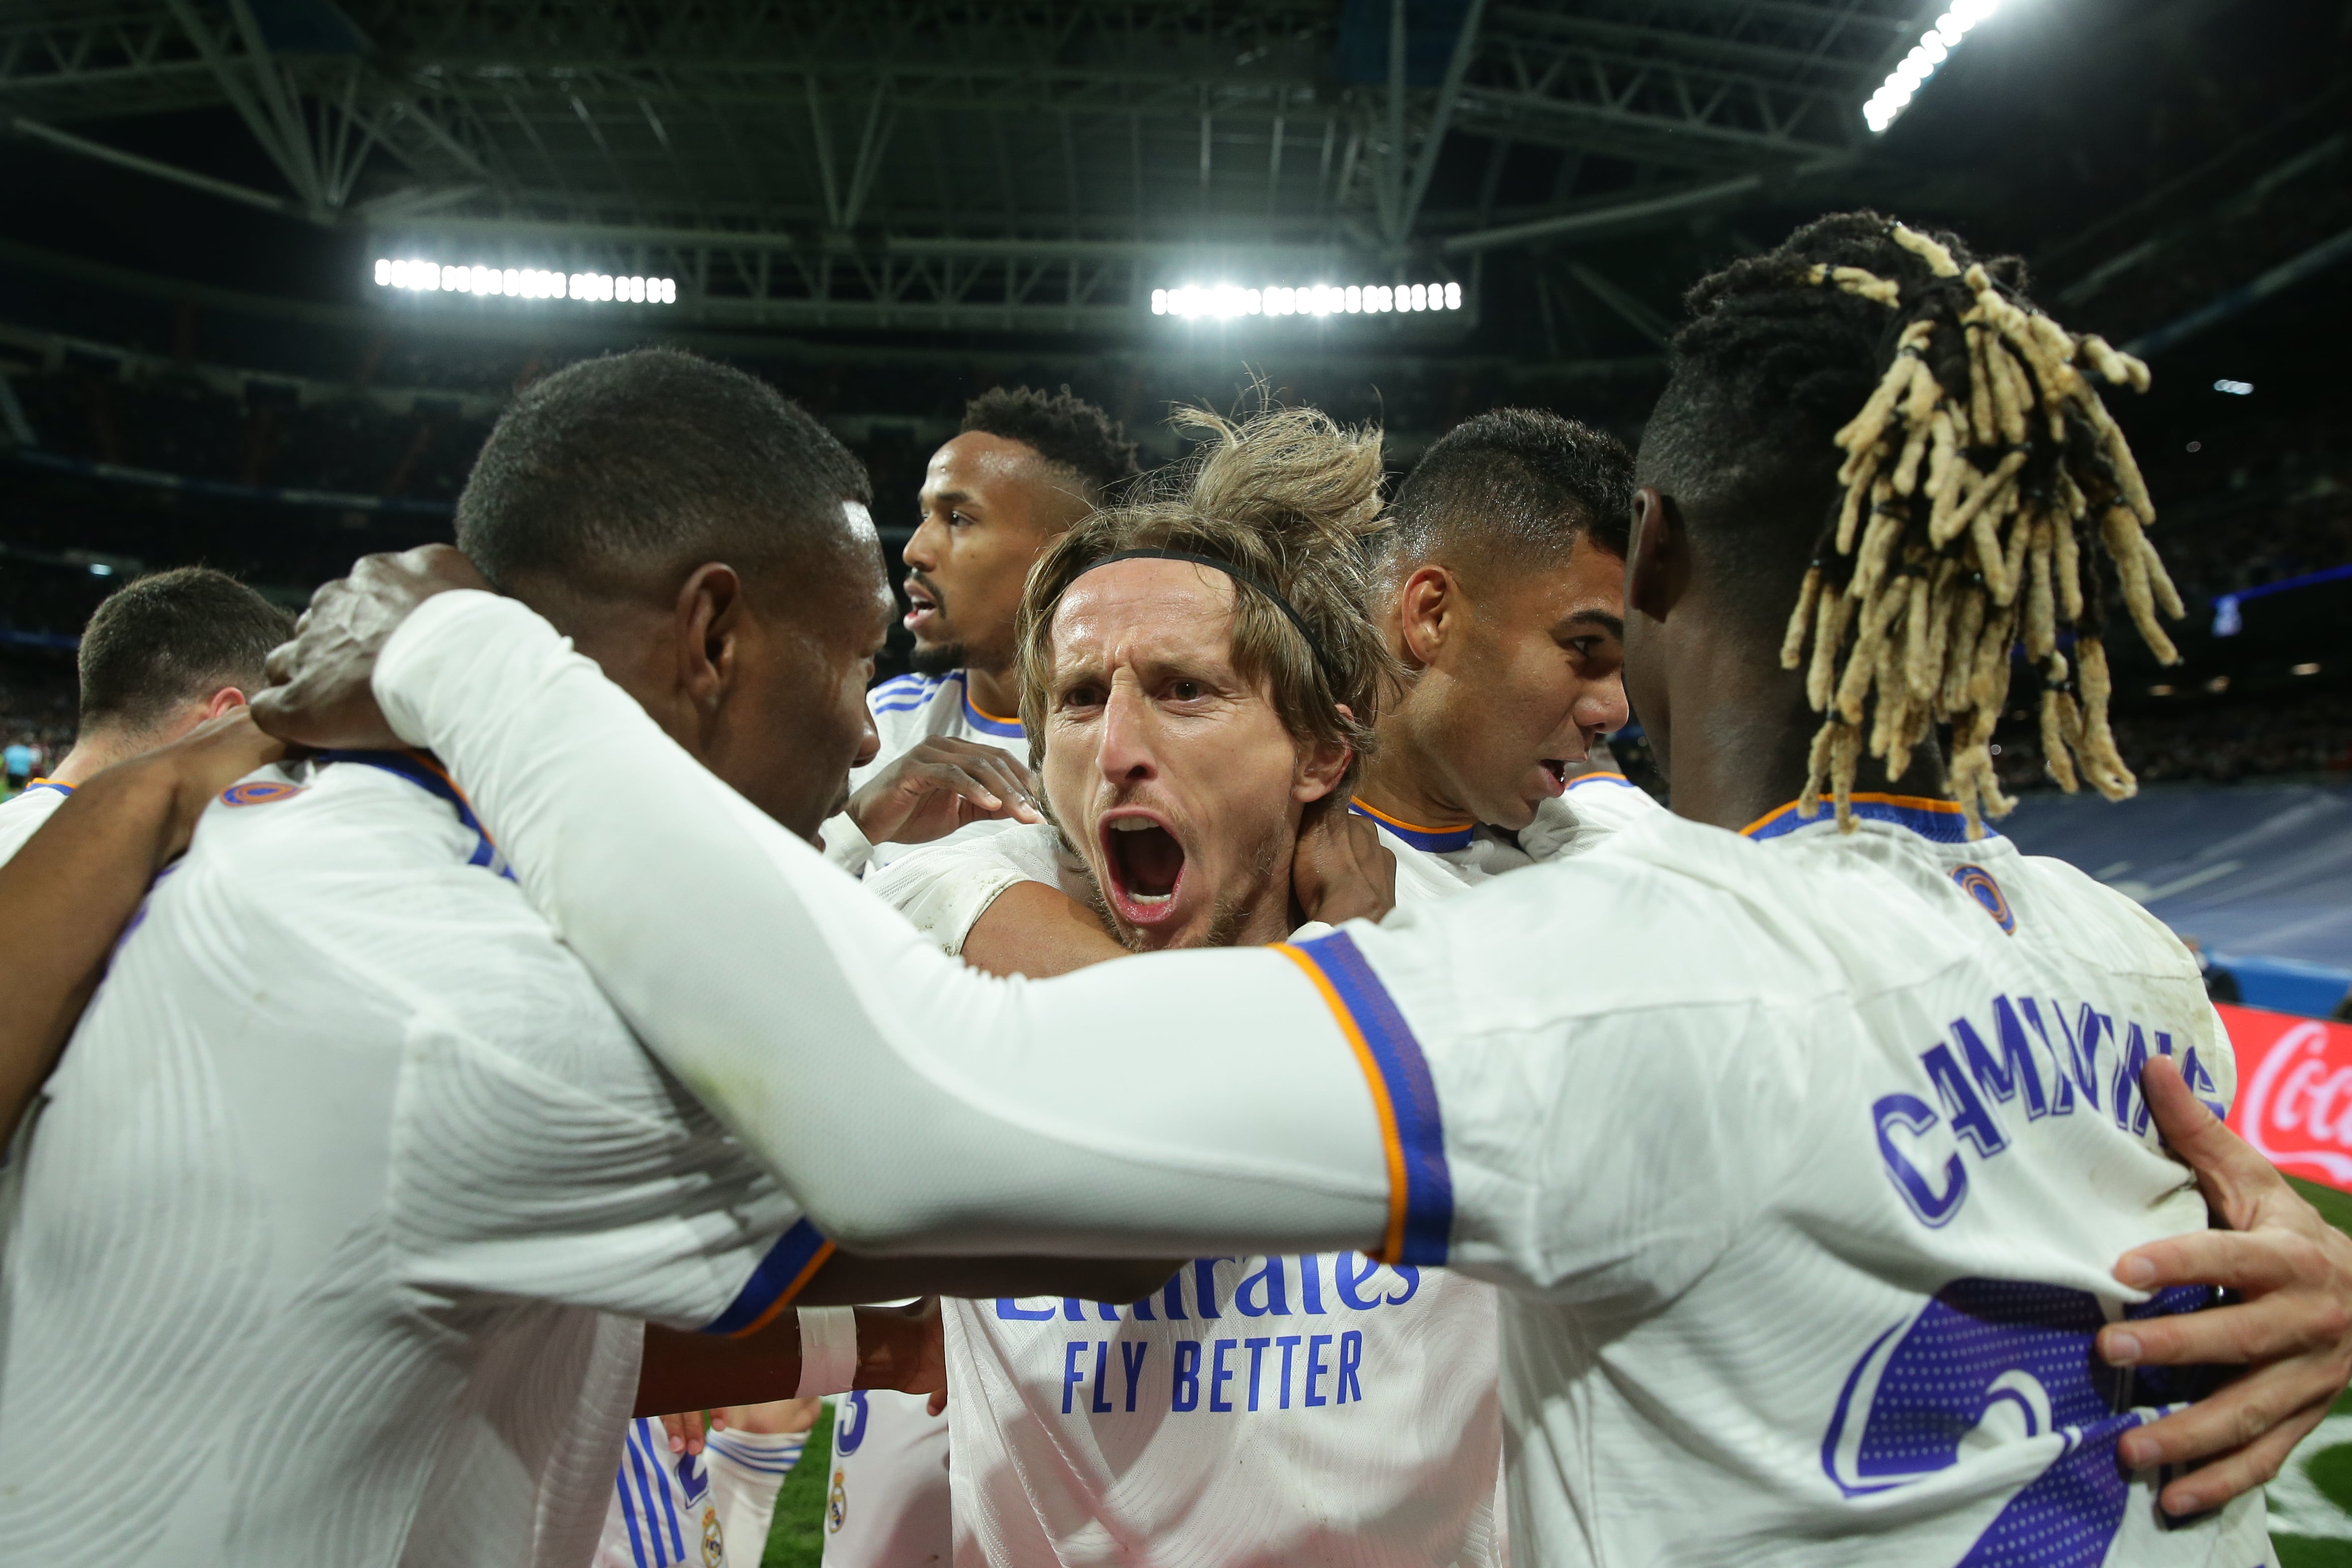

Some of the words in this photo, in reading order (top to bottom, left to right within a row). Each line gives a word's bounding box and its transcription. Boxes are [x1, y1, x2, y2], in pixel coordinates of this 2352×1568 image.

[996, 1250, 1420, 1322] rates
[1062, 1341, 1147, 1414] FLY
[1172, 1330, 1363, 1412] BETTER
